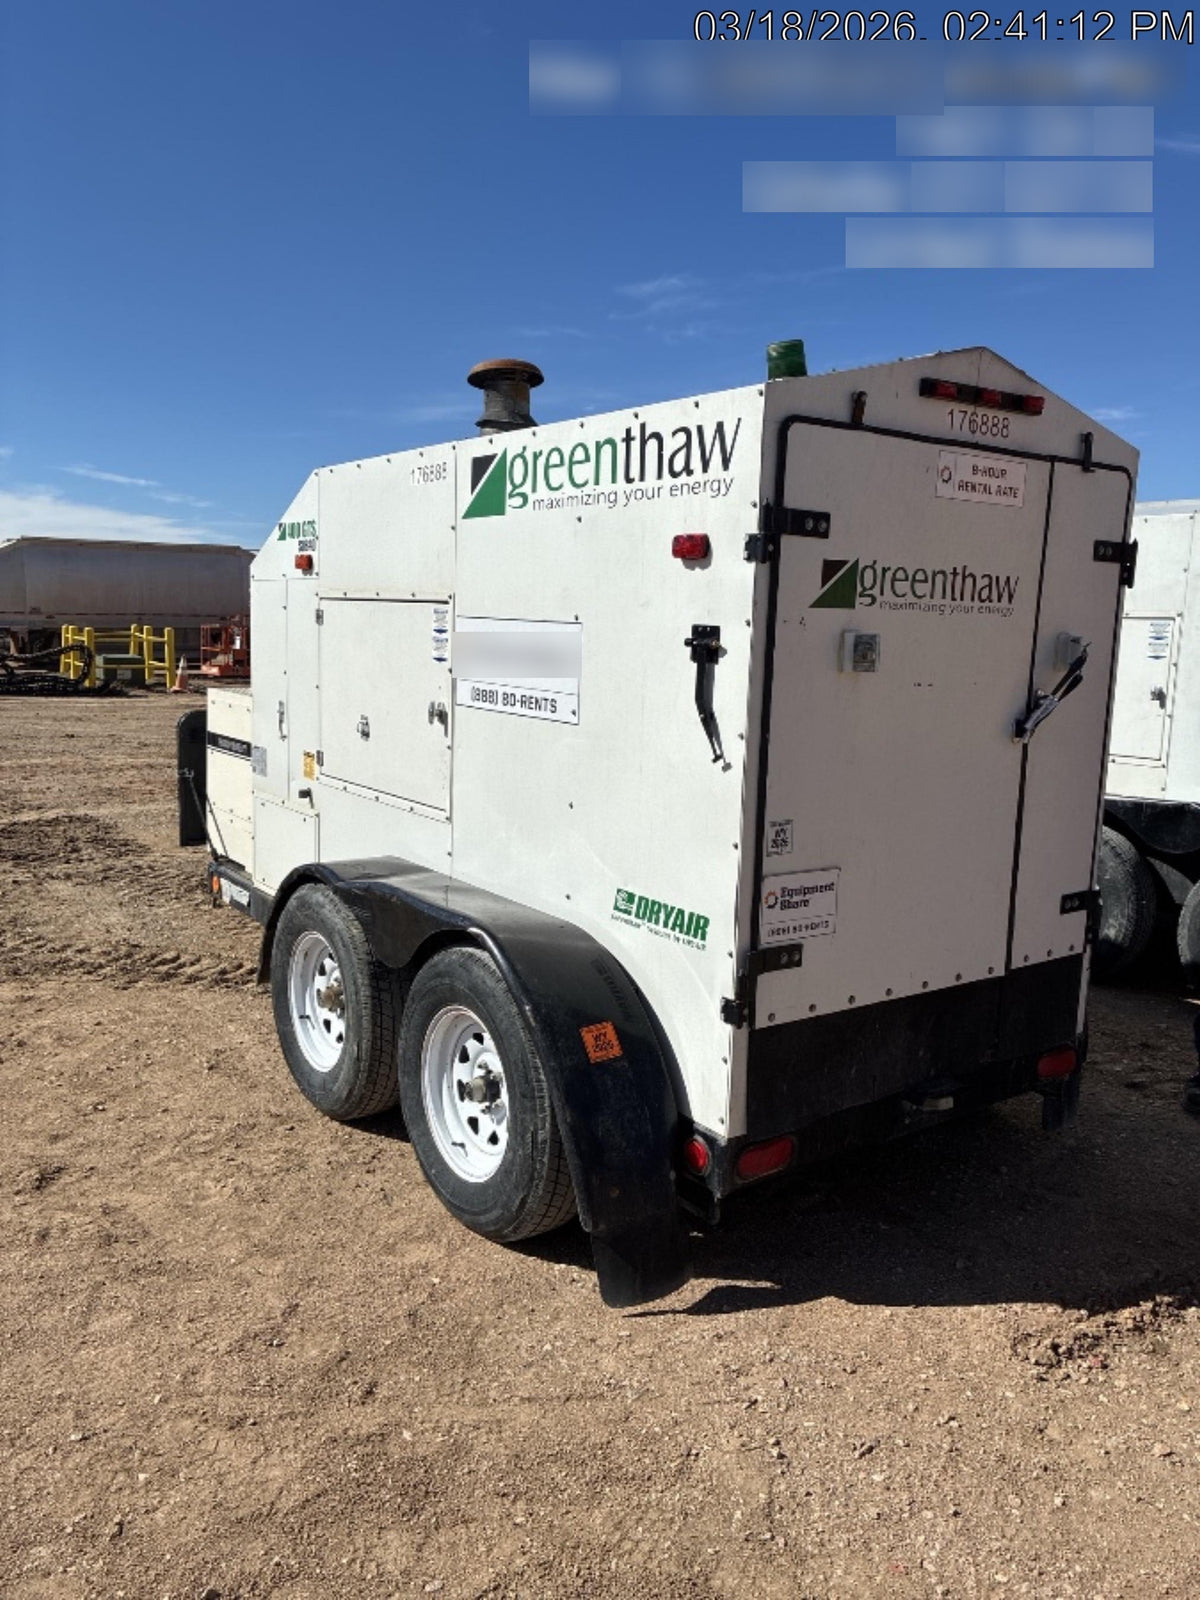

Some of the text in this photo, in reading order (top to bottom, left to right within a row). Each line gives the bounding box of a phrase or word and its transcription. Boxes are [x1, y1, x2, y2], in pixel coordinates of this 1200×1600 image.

[946, 408, 1009, 439] 176888
[508, 417, 742, 509] greenthaw
[532, 477, 735, 512] maximizing your energy
[957, 480, 1020, 499] RENTAL RATE
[858, 559, 1020, 607] greenthaw
[879, 600, 1014, 618] maximizing your energy
[470, 686, 557, 714] (888) 80-RENTS
[780, 882, 836, 899] Equipment
[634, 895, 710, 942] DRYAIR
[780, 900, 810, 911] Share
